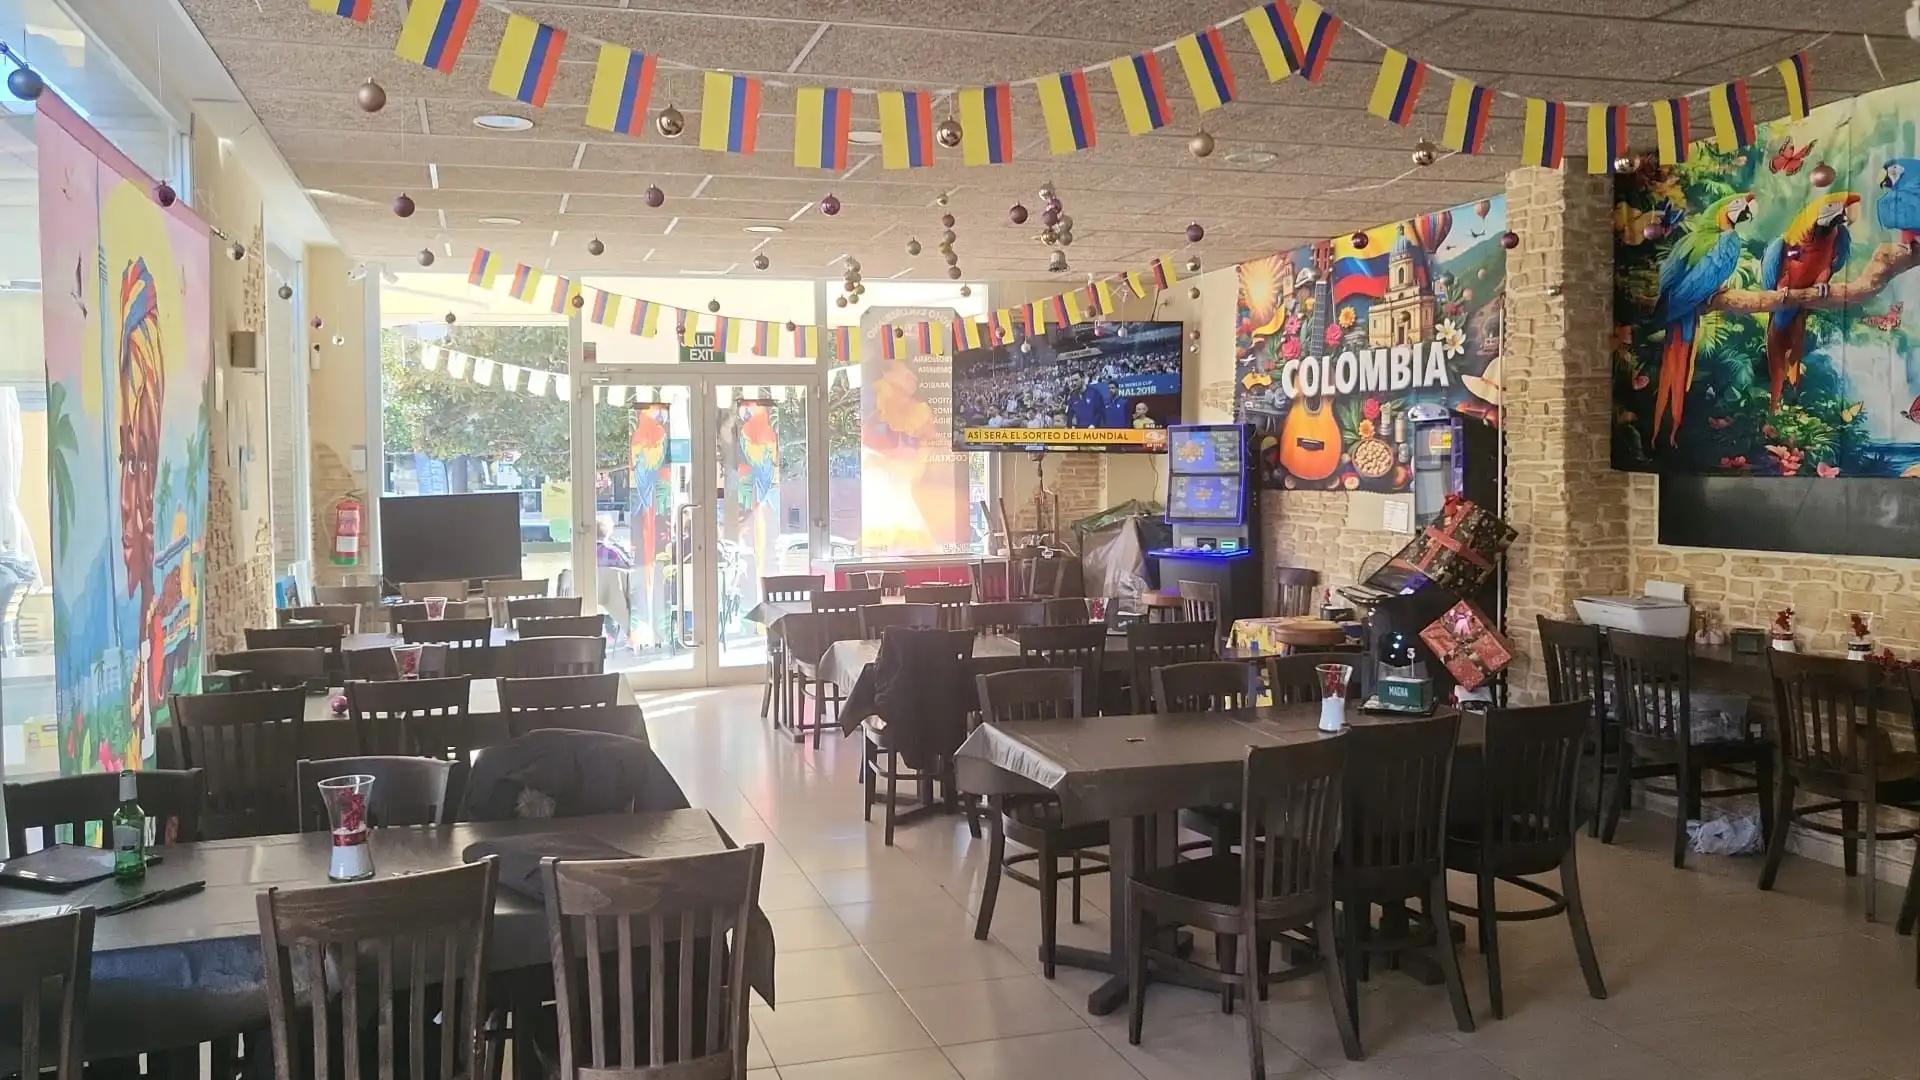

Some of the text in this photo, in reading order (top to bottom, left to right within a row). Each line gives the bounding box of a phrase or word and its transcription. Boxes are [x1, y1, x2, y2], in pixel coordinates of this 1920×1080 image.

[690, 349, 714, 360] EXIT
[1282, 341, 1449, 399] COLOMBIA
[1118, 387, 1135, 397] NAL
[968, 429, 1128, 441] ASÍ SERÁ EL SORTEO DEL MUNDIAL
